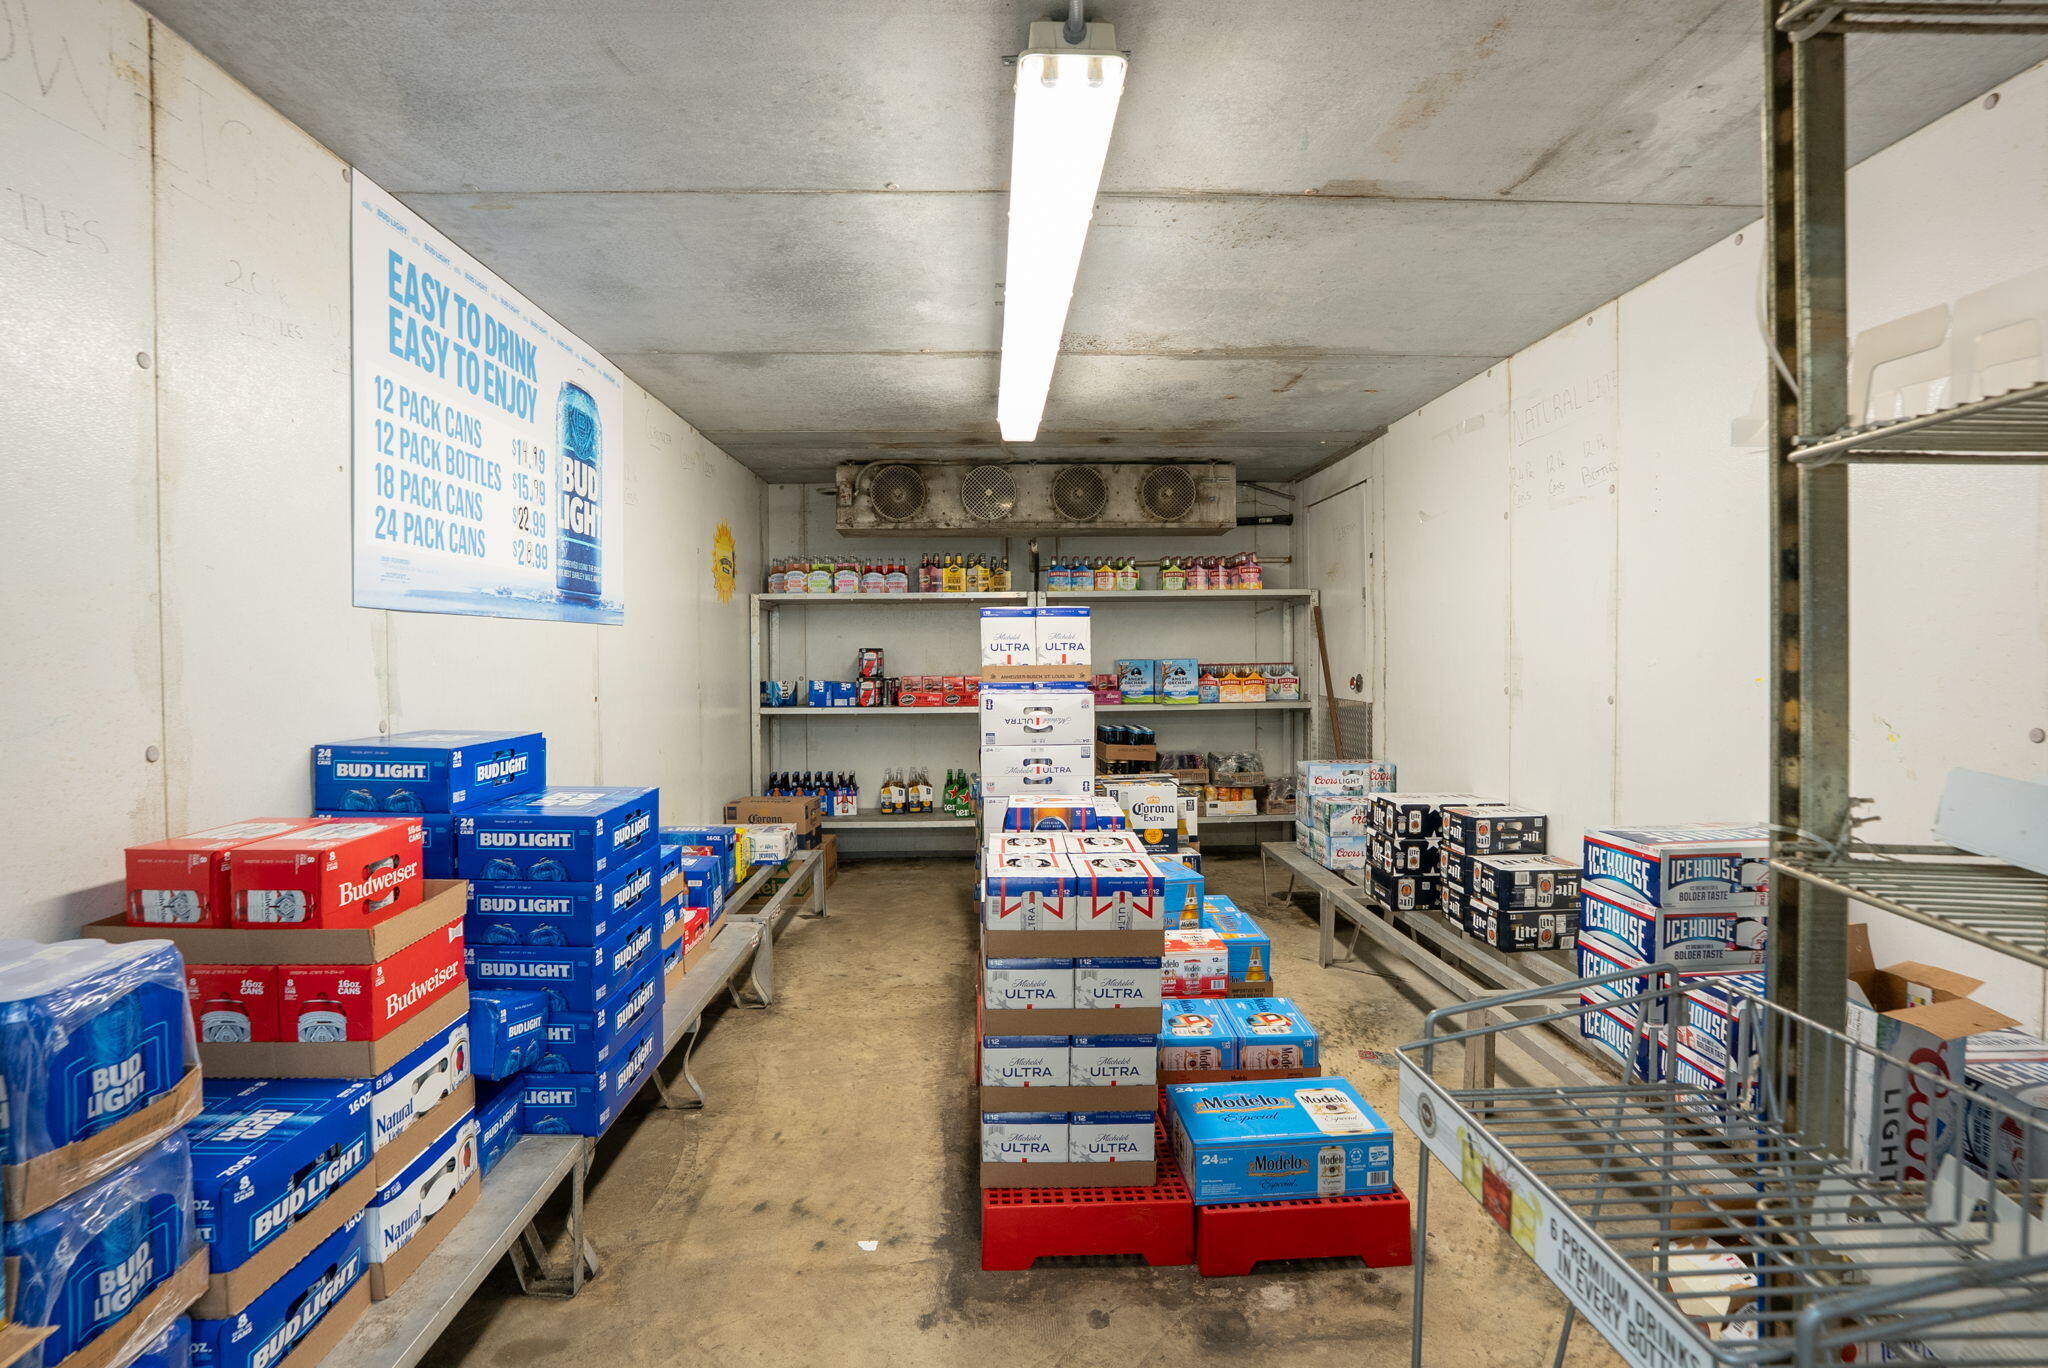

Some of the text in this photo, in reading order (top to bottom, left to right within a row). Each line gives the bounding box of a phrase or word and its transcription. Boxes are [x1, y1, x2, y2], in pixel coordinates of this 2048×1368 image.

[388, 248, 450, 328] EASY
[453, 292, 481, 348] TO
[485, 312, 538, 383] DRINK
[388, 304, 538, 424] EASY TO ENJOY
[374, 375, 483, 449] 12 PACK CANS
[374, 419, 502, 492] 12 PACK BOTTLES
[562, 455, 599, 504] BUD
[374, 462, 483, 522] 18 PACK CANS
[512, 505, 546, 539] $22.99
[558, 494, 602, 540] LIGHT
[374, 505, 486, 558] 24 PACK CANS
[990, 643, 1030, 652] ULTRA
[1045, 642, 1085, 651] ULTRA
[781, 680, 789, 699] BUS
[317, 748, 331, 758] 24
[453, 751, 462, 760] 24
[336, 763, 425, 779] BUD LIGHT
[476, 756, 527, 782] BUD LIGHT
[1005, 766, 1072, 775] Michelob ULTRA
[1314, 775, 1361, 785] Coors LIGHT
[1131, 802, 1175, 818] Corona
[1143, 813, 1165, 822] Extra
[460, 818, 475, 827] 24
[748, 813, 782, 825] Corona
[613, 814, 650, 846] BUD LIGHT
[1522, 831, 1541, 842] Lite
[479, 833, 571, 847] BUD LIGHT
[1335, 847, 1361, 858] Coors
[1588, 844, 1654, 899] ICEHOUSE
[1670, 857, 1740, 884] ICEHOUSE
[338, 860, 418, 907] Budweiser
[613, 871, 651, 909] BUD LIGHT
[1555, 882, 1578, 897] Lite
[1679, 891, 1728, 901] BOLDER TASTE
[479, 898, 570, 913] BUD LIGHT
[1472, 913, 1487, 929] Lite
[1585, 897, 1648, 956] ICEHOUSE
[1514, 924, 1538, 941] Lite
[1665, 918, 1734, 944] ICEHOUSE
[614, 928, 652, 971] BUD LIGHT
[1674, 949, 1724, 960] BOLDER TASTE
[480, 963, 571, 978] BUD LIGHT
[1162, 960, 1180, 968] odelo
[386, 960, 459, 1020] Budweiser
[1012, 979, 1047, 988] Michelob
[1100, 978, 1135, 987] Michelob
[240, 987, 264, 996] CANS
[338, 987, 361, 995] CANS
[1005, 989, 1055, 999] ULTRA
[1093, 988, 1143, 999] ULTRA
[616, 981, 654, 1031] BUD LIGHT
[508, 1016, 542, 1038] BUD LIGHT
[1688, 1001, 1729, 1046] HOUSE
[617, 1035, 654, 1088] BUD LIGHT
[1009, 1057, 1044, 1066] Michelob
[1097, 1057, 1131, 1066] Michelob
[1281, 1047, 1293, 1070] Mode
[92, 1052, 142, 1093] BUD
[1002, 1067, 1053, 1077] ULTRA
[1090, 1067, 1140, 1077] ULTRA
[87, 1070, 146, 1120] LIGHT
[524, 1090, 573, 1104] LIGHT
[1200, 1094, 1280, 1110] Modelo
[1300, 1094, 1348, 1105] Modelo
[376, 1097, 414, 1138] Natural
[484, 1102, 518, 1145] BUD LIGHT
[1219, 1111, 1279, 1124] Especial
[1008, 1133, 1043, 1142] Michelob
[1096, 1133, 1130, 1142] Michelob
[1879, 1088, 1901, 1182] LIGHT
[1001, 1143, 1051, 1153] ULTRA
[1089, 1143, 1138, 1153] ULTRA
[1202, 1154, 1219, 1165] 24
[1255, 1153, 1302, 1172] Modelo
[1319, 1153, 1344, 1166] Modelo
[240, 1175, 250, 1190] 8
[1260, 1179, 1298, 1190] Especial
[234, 1190, 255, 1204] CANS
[254, 1140, 364, 1242] BUD LIGHT
[384, 1203, 422, 1248] Natural
[99, 1241, 150, 1294] BUD
[1550, 1217, 1558, 1241] 6
[1562, 1228, 1630, 1315] PREMIUM
[93, 1257, 154, 1322] LIGHT
[1557, 1250, 1573, 1280] IN
[1576, 1272, 1622, 1332] EVERY
[252, 1255, 358, 1368] BUD LIGHT
[237, 1313, 249, 1329] 8
[231, 1325, 253, 1344] CANS
